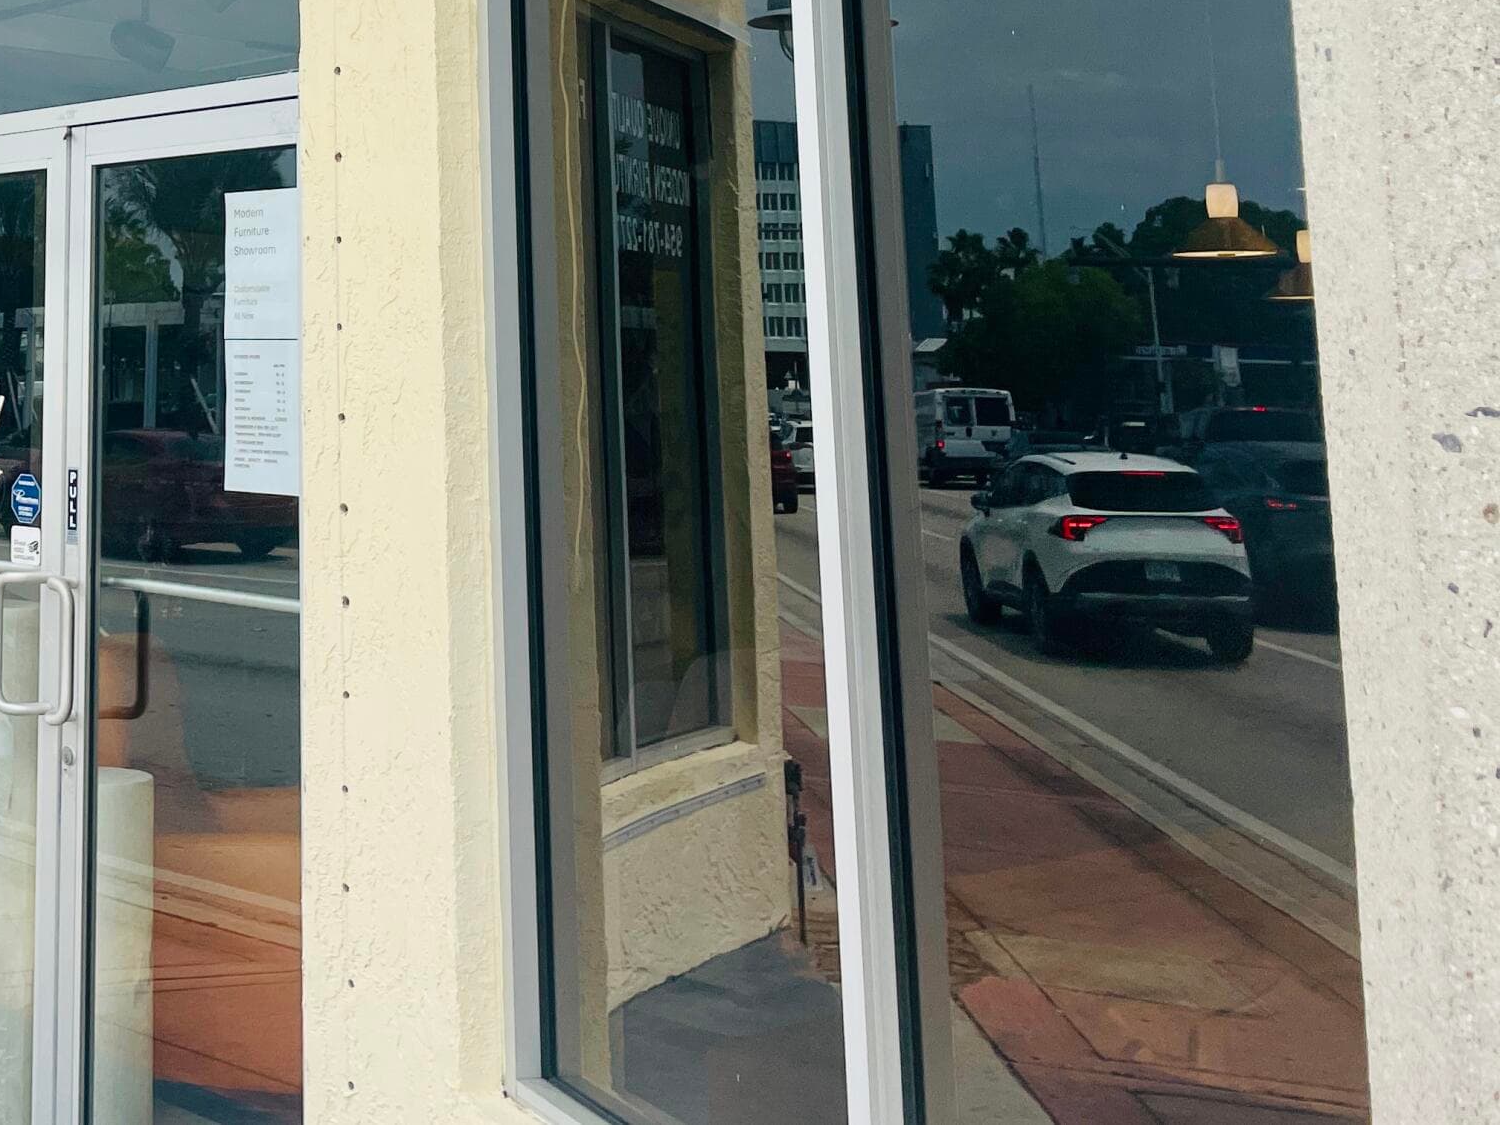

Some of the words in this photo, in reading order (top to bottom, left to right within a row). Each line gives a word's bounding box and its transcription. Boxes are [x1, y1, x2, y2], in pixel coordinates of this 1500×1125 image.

[233, 227, 270, 237] Furniture
[233, 245, 277, 257] Showroom
[69, 471, 77, 529] PULL
